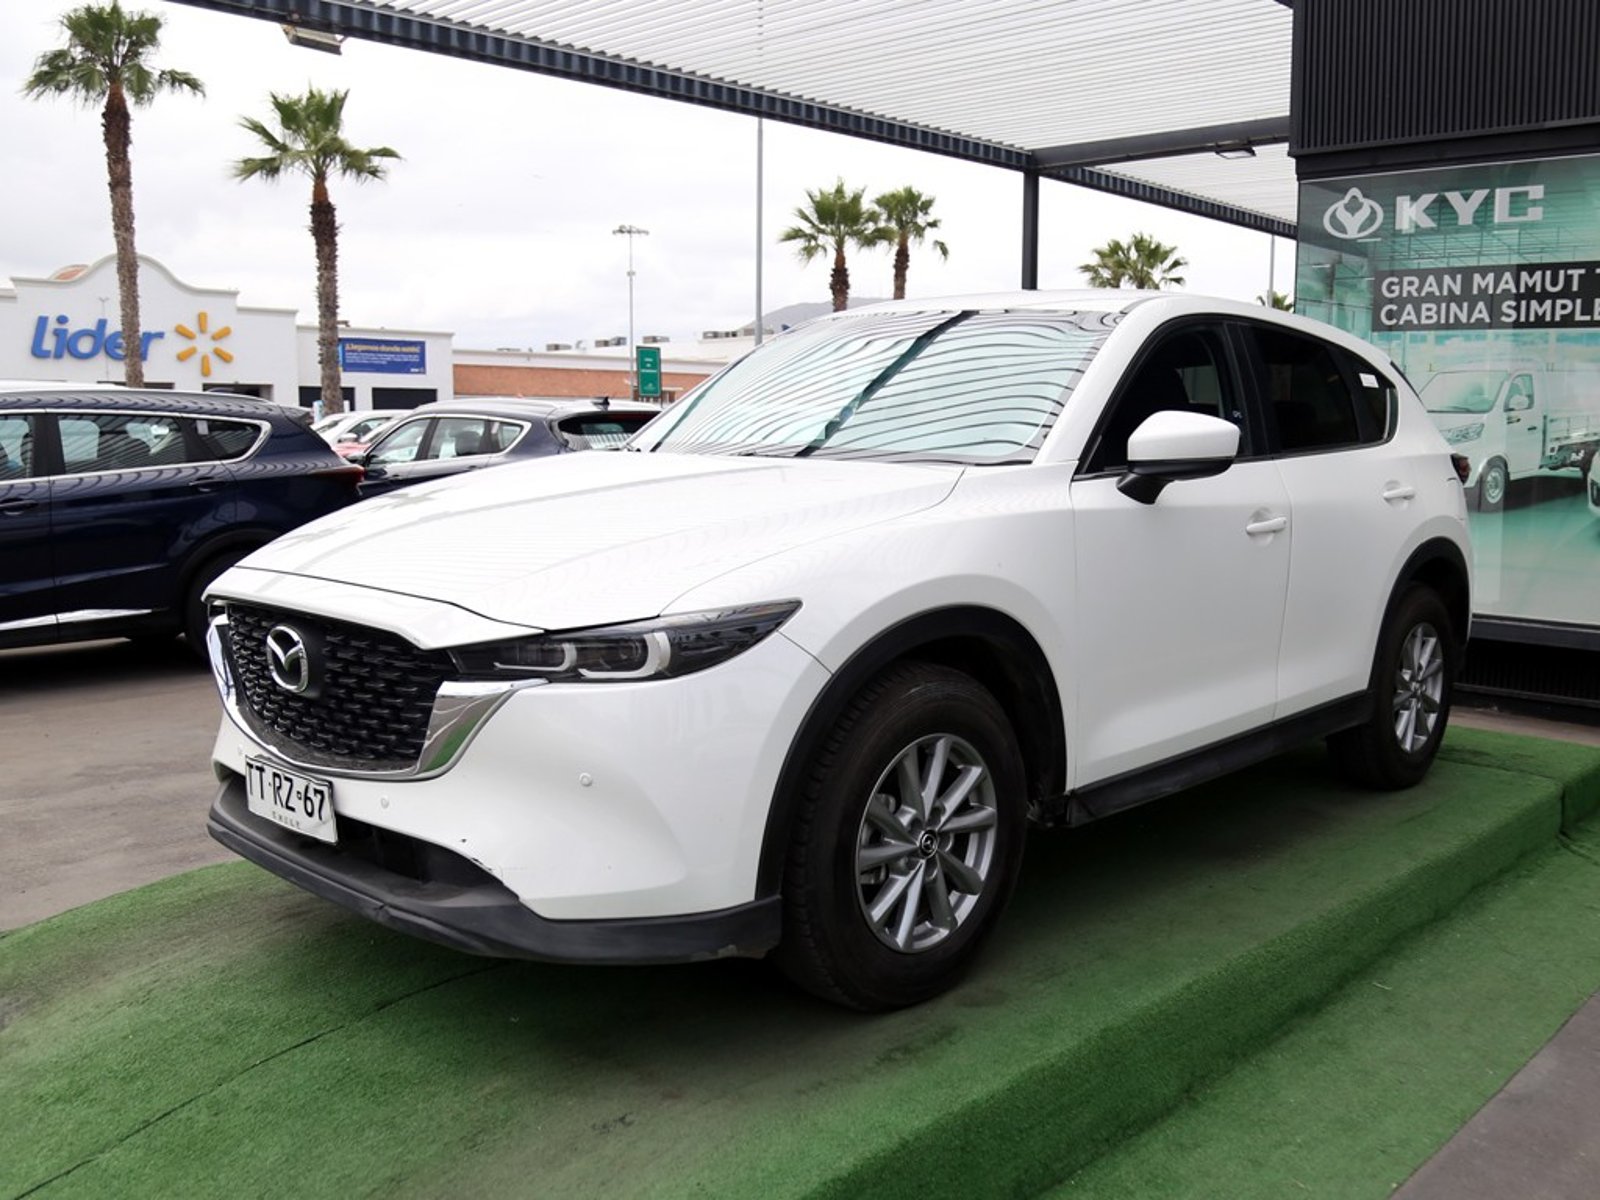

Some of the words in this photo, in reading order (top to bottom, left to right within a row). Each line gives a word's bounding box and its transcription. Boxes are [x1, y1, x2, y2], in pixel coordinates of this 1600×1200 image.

[1395, 184, 1544, 231] KYC
[1381, 275, 1462, 298] GRAN
[1472, 269, 1585, 295] MAMUT
[1380, 302, 1491, 325] CABINA
